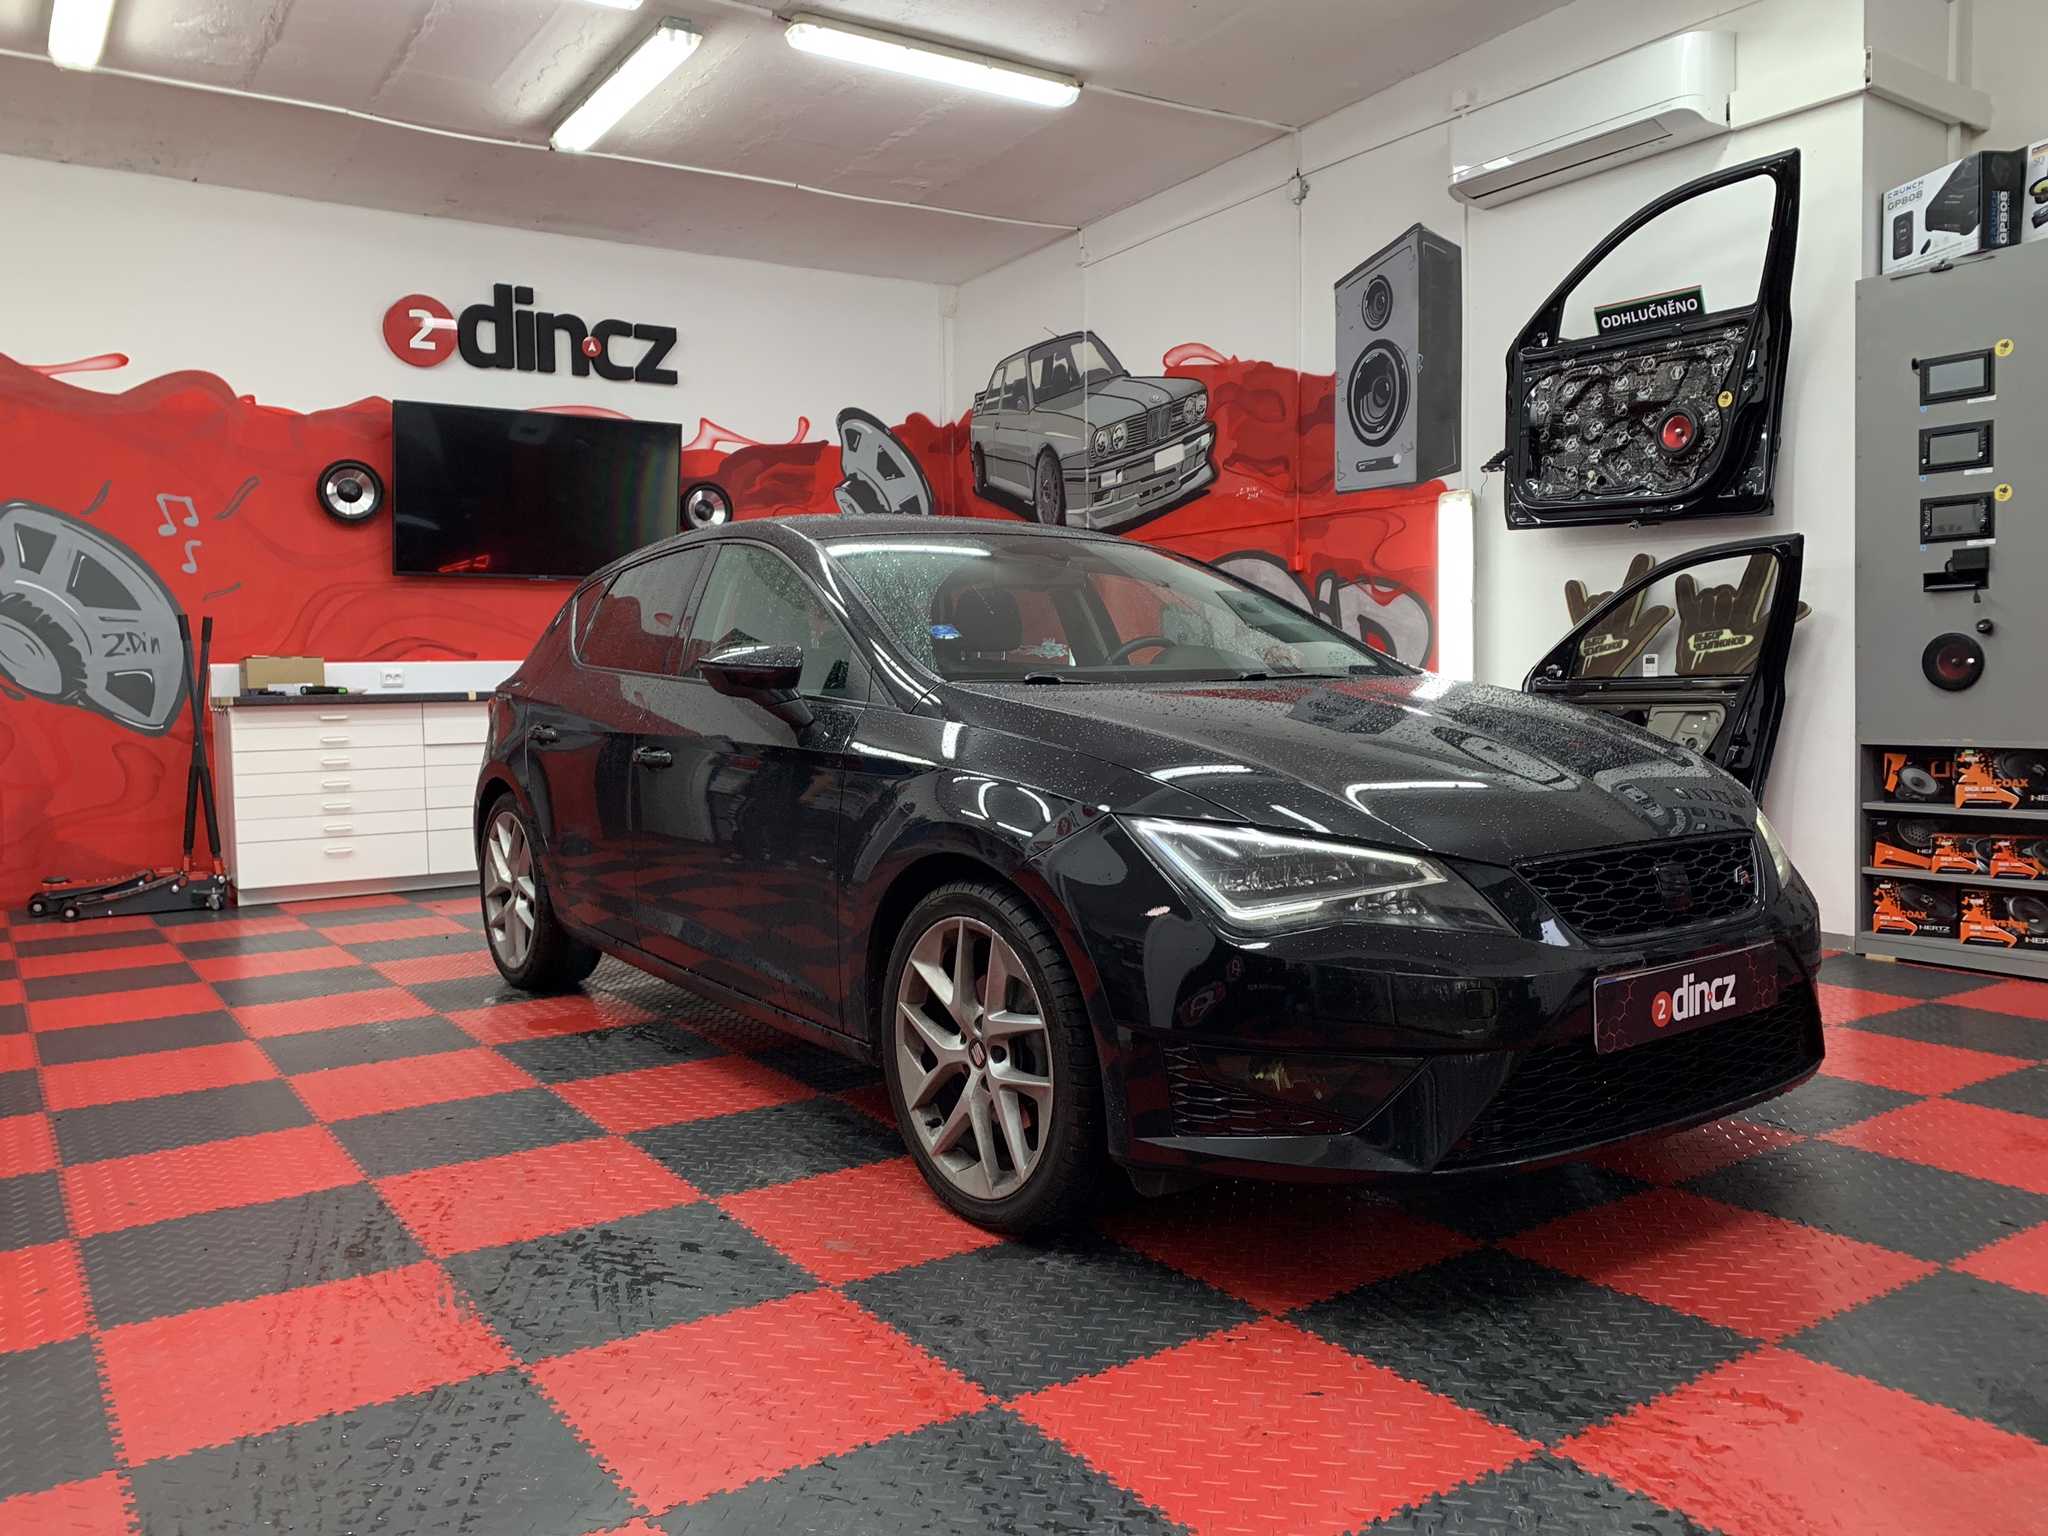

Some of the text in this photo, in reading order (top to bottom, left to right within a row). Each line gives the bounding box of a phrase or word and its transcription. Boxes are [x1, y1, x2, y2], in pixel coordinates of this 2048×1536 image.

[1887, 190, 1923, 211] GP808
[1999, 191, 2008, 244] GP808
[1601, 298, 1698, 328] ODHLUČNĚNO
[1994, 778, 2029, 788] COAX
[1900, 910, 1928, 920] COAX
[1919, 924, 1951, 933] HERTZ
